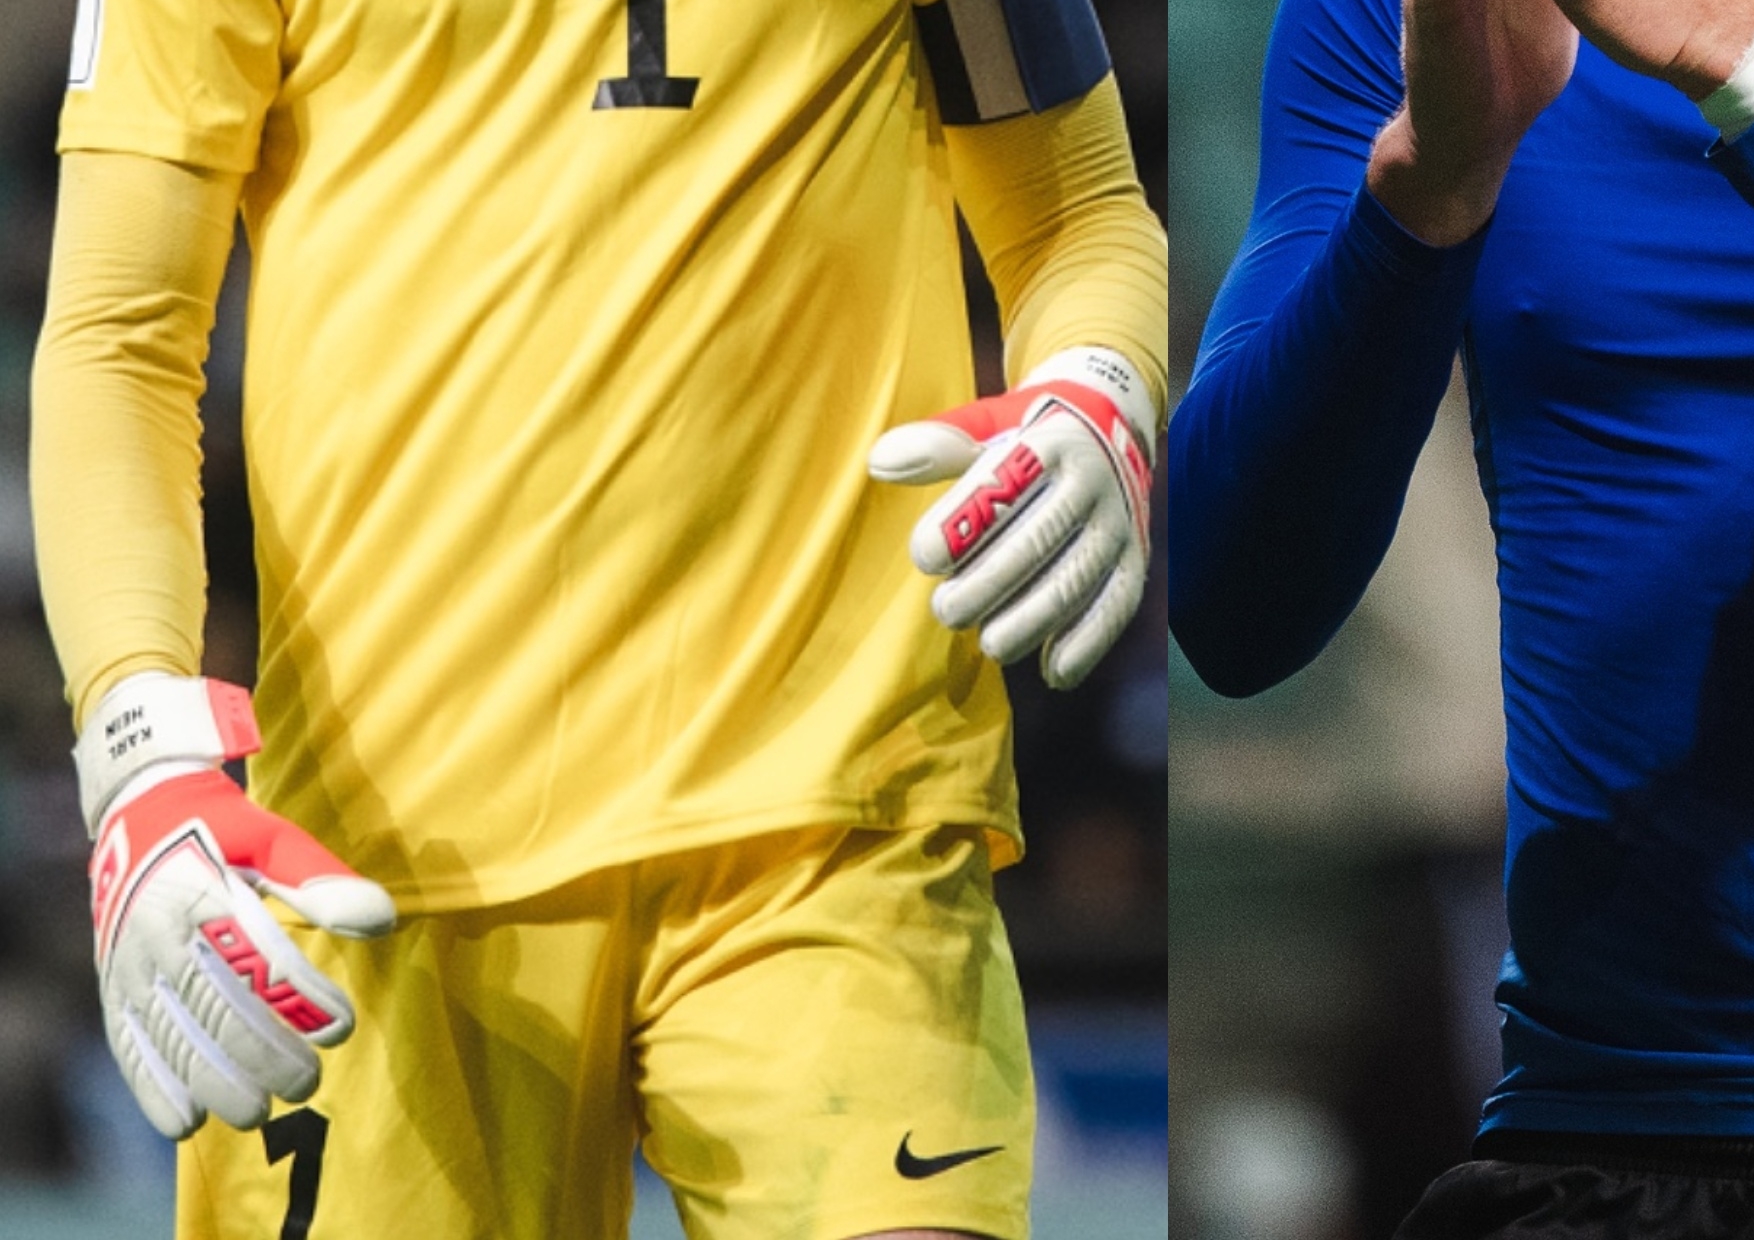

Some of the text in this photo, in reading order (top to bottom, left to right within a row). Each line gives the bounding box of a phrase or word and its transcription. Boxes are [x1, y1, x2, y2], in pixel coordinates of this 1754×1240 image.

[941, 441, 1045, 561] ONE
[109, 725, 152, 760] KARL
[200, 918, 338, 1035] ONE
